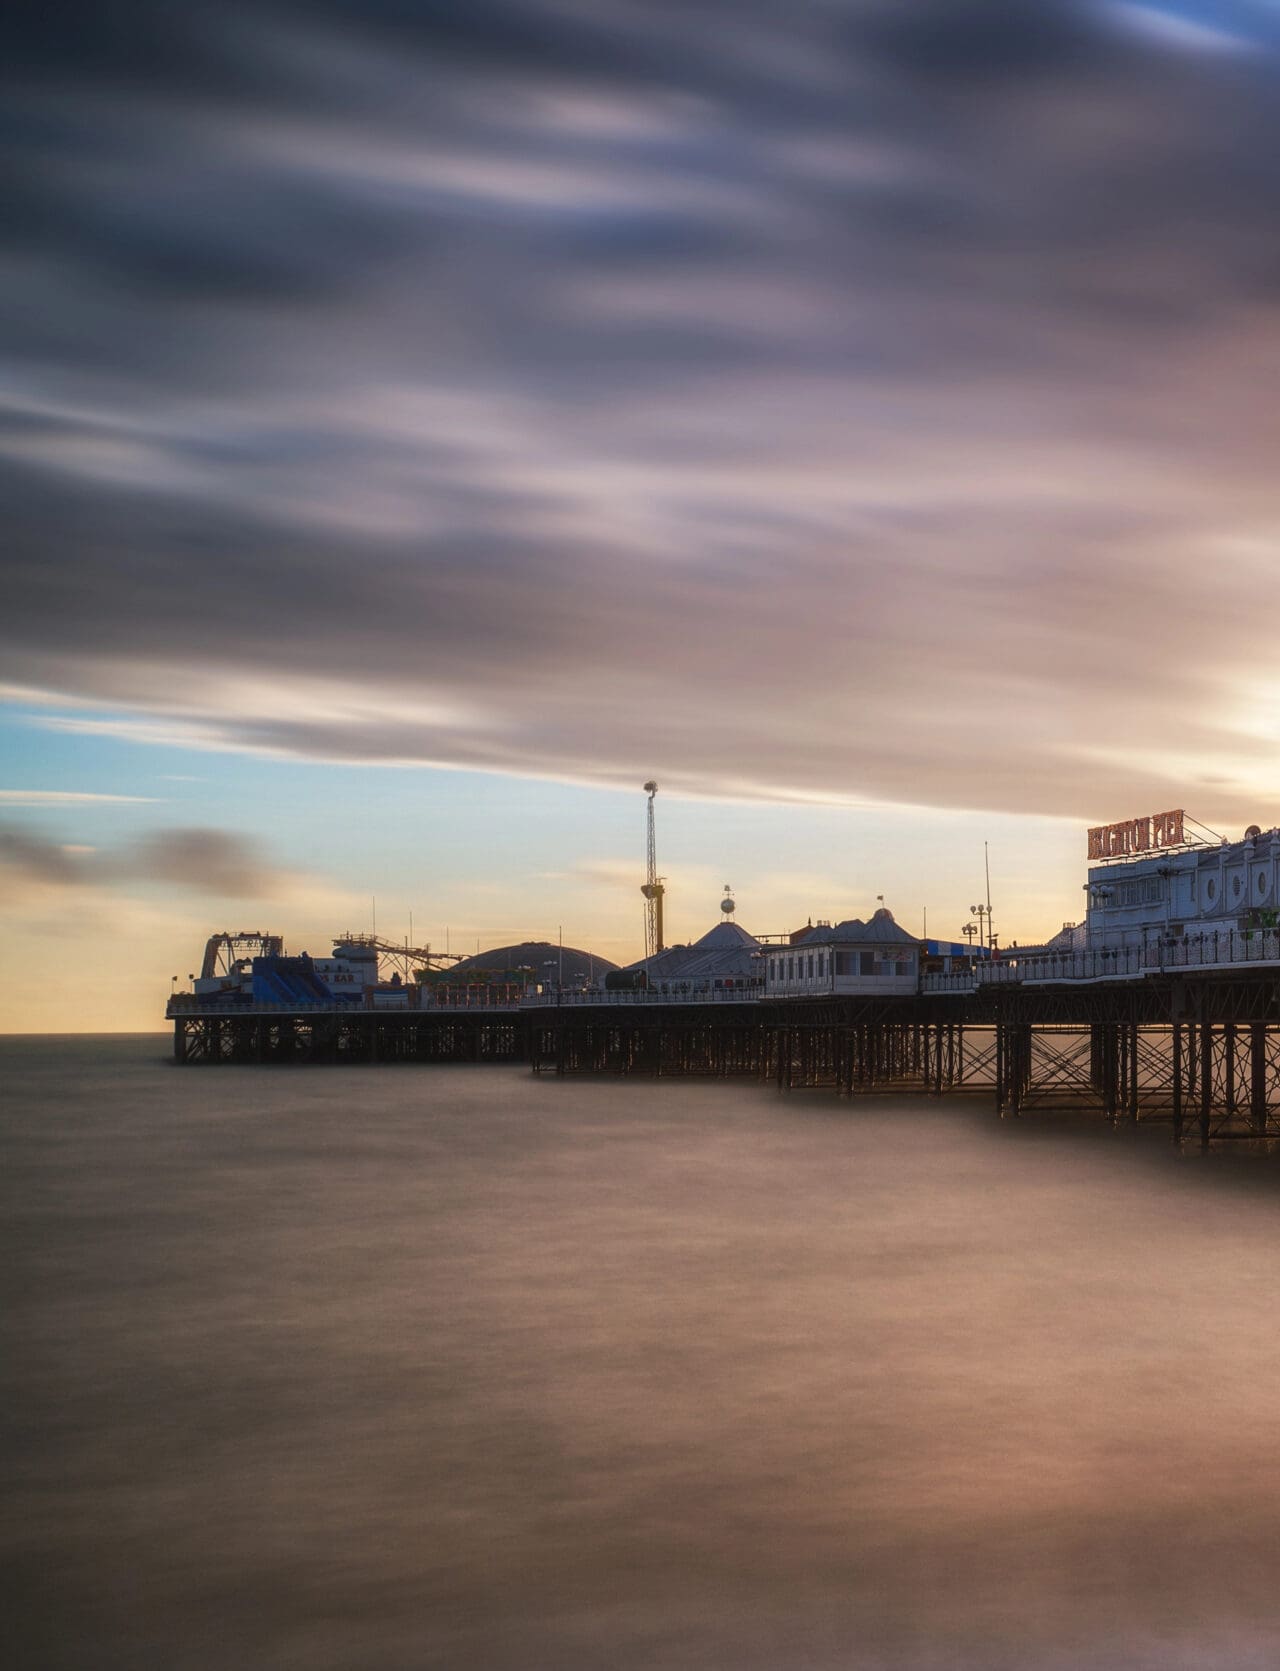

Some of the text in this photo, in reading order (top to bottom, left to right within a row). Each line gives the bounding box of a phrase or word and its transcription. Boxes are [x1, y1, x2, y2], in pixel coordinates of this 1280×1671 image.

[1087, 809, 1185, 860] BRIGHTON PIER
[334, 974, 354, 983] BAR
